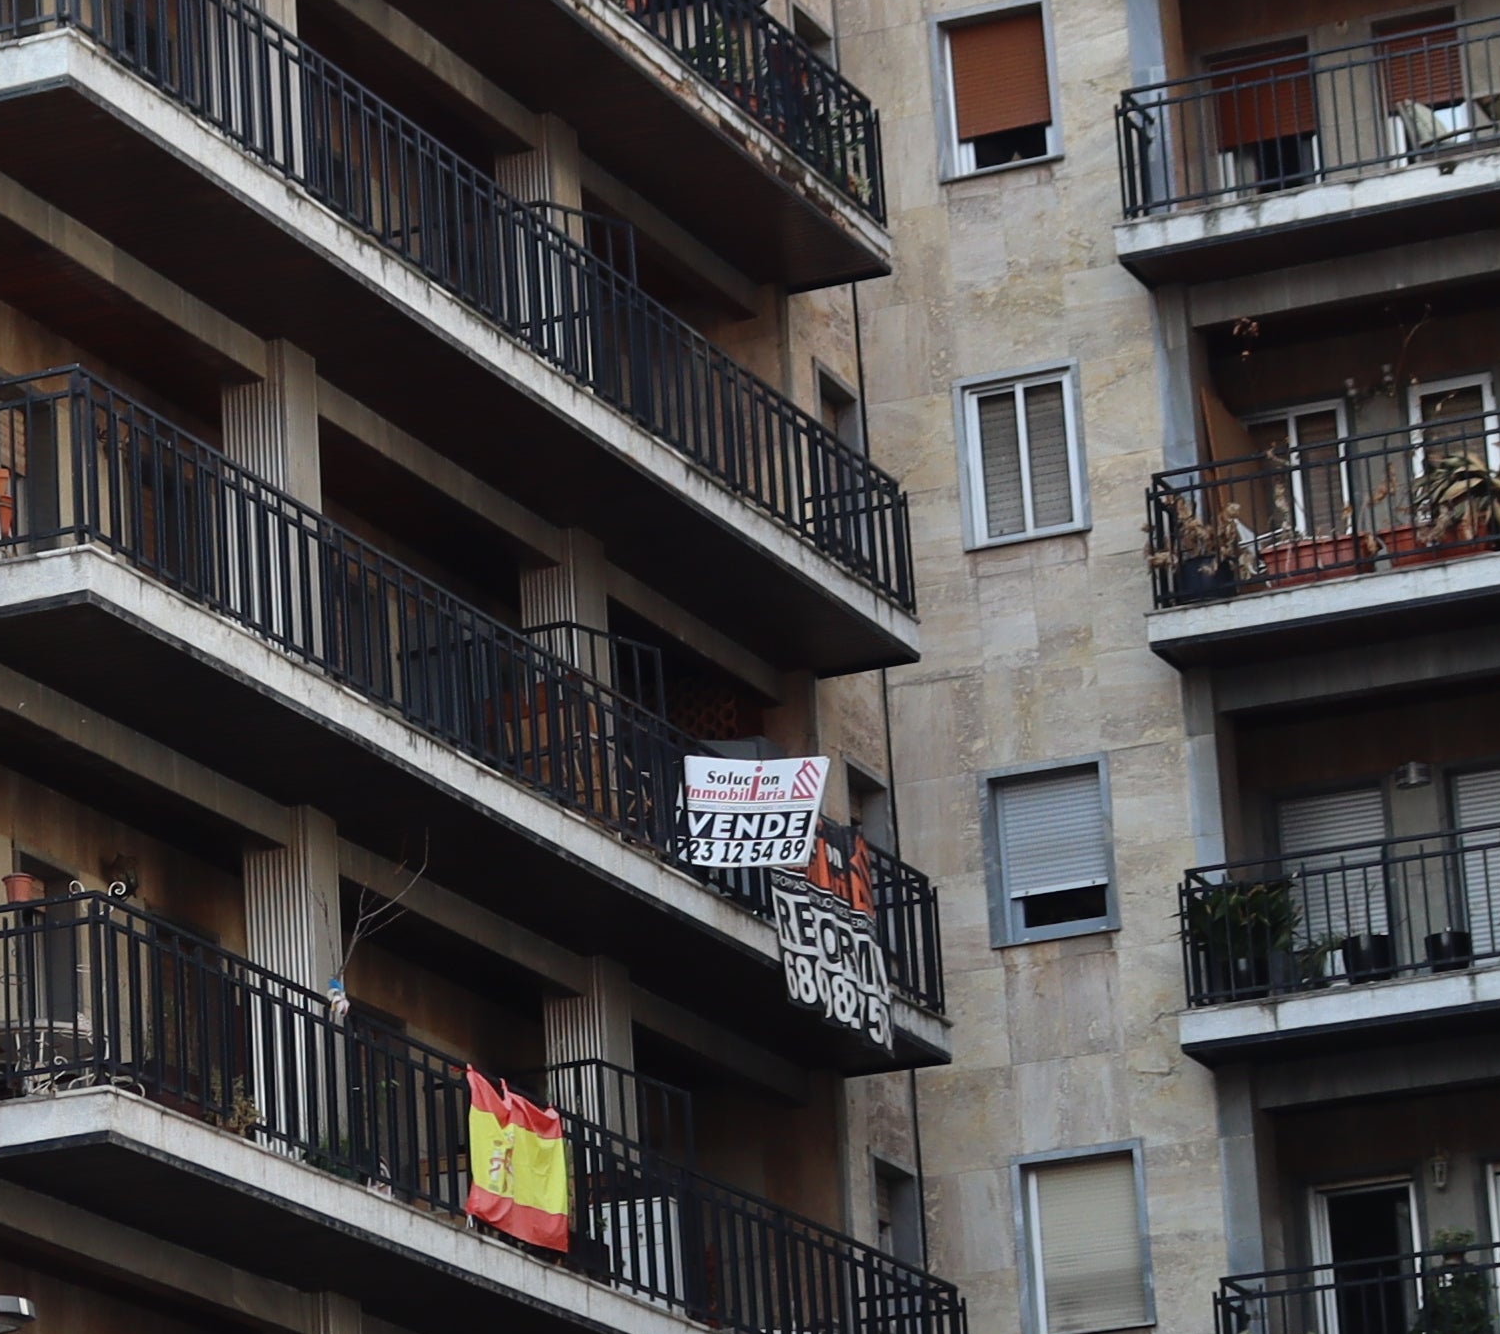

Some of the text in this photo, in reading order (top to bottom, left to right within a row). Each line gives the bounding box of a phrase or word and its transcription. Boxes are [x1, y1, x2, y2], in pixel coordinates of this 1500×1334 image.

[688, 812, 807, 839] VENDE
[720, 842, 744, 863] 12
[750, 841, 773, 862] 54
[780, 839, 806, 861] 89
